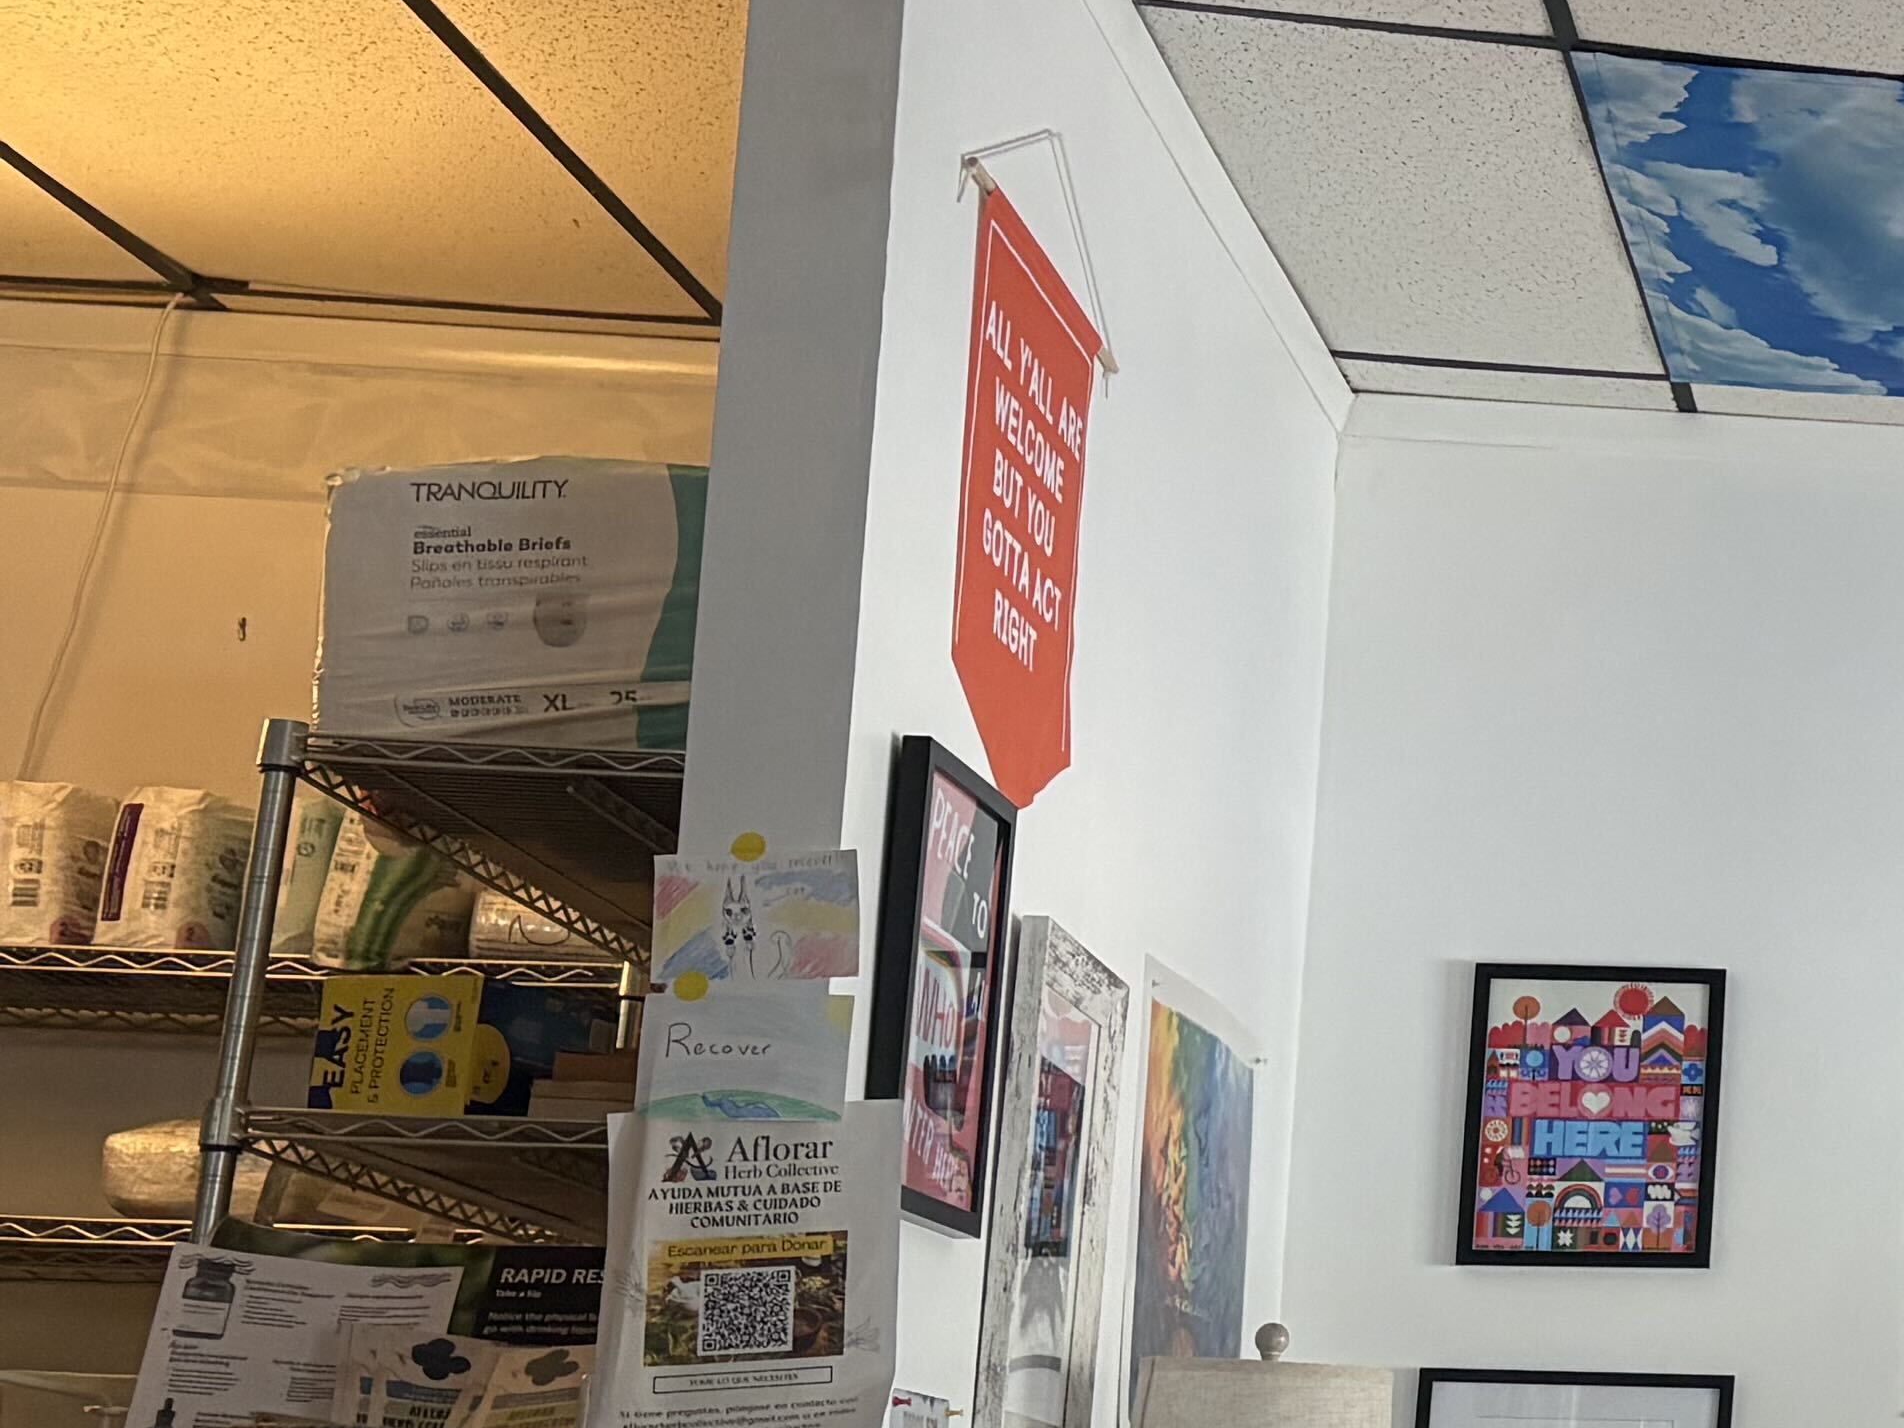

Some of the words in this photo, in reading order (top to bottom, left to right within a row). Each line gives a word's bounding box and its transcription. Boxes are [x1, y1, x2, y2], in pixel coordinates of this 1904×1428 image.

[985, 300, 1013, 371] ALL
[1019, 337, 1054, 424] Y'ALL
[1057, 396, 1083, 463] ARE
[995, 376, 1064, 503] WELCOME
[410, 479, 569, 502] TRANQUILITY
[992, 449, 1023, 518] BUT
[1027, 486, 1055, 557] YOU
[413, 526, 472, 539] essential
[413, 539, 513, 555] Breathable
[518, 537, 572, 552] Briefs
[411, 559, 448, 573] Slips
[452, 561, 472, 572] en
[477, 556, 512, 570] tissu
[518, 555, 588, 570] respirant
[982, 508, 1031, 602] GOTTA
[1032, 568, 1063, 631] ACT
[992, 588, 1038, 673] RIGHT
[448, 694, 521, 707] MODERATE
[542, 693, 575, 713] XL
[931, 788, 975, 880] PEACE
[971, 892, 988, 940] TO
[323, 1004, 355, 1088] EASY
[351, 999, 376, 1094] PLACEMENT
[368, 987, 395, 1089] PROTECTION
[665, 1022, 771, 1058] Recover
[1552, 1045, 1641, 1082] YOU
[1508, 1082, 1680, 1120] BELONG
[727, 1135, 834, 1163] Aflorar
[1533, 1119, 1645, 1159] HERE
[724, 1163, 763, 1181] Herb
[766, 1162, 839, 1178] Collective
[648, 1185, 703, 1200] AYUDA
[706, 1183, 763, 1199] MUTUA
[766, 1183, 779, 1197] A
[781, 1181, 820, 1195] BASE
[823, 1180, 842, 1193] DE
[668, 1199, 733, 1215] HIERBAS
[737, 1199, 749, 1212] &
[753, 1196, 821, 1211] CUIDADO
[690, 1212, 799, 1229] COMUNITARIO
[668, 1243, 738, 1258] Escanear
[742, 1242, 777, 1256] para
[781, 1238, 826, 1253] Donar
[500, 1268, 566, 1284] RAPID
